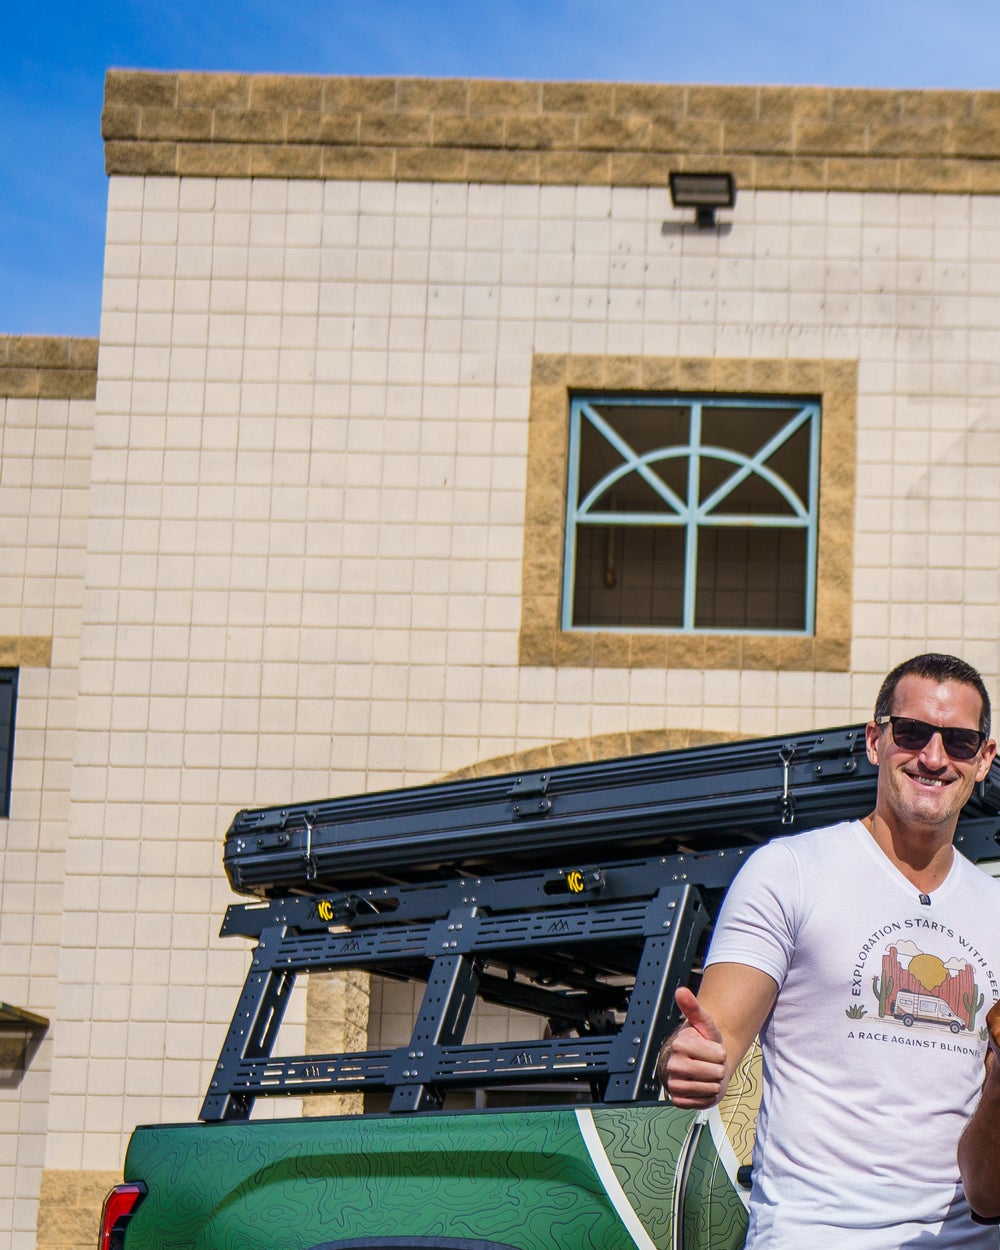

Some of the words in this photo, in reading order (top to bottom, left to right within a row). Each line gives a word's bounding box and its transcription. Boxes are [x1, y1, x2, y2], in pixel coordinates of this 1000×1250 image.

[567, 871, 584, 893] KC
[317, 900, 334, 921] KC
[851, 921, 901, 997] EXPLORATION
[904, 918, 954, 938] STARTS
[959, 935, 987, 968] WITH
[985, 970, 999, 1005] SEEI
[847, 1031, 855, 1040] A
[858, 1032, 888, 1043] RACE
[890, 1035, 938, 1050] AGAINST
